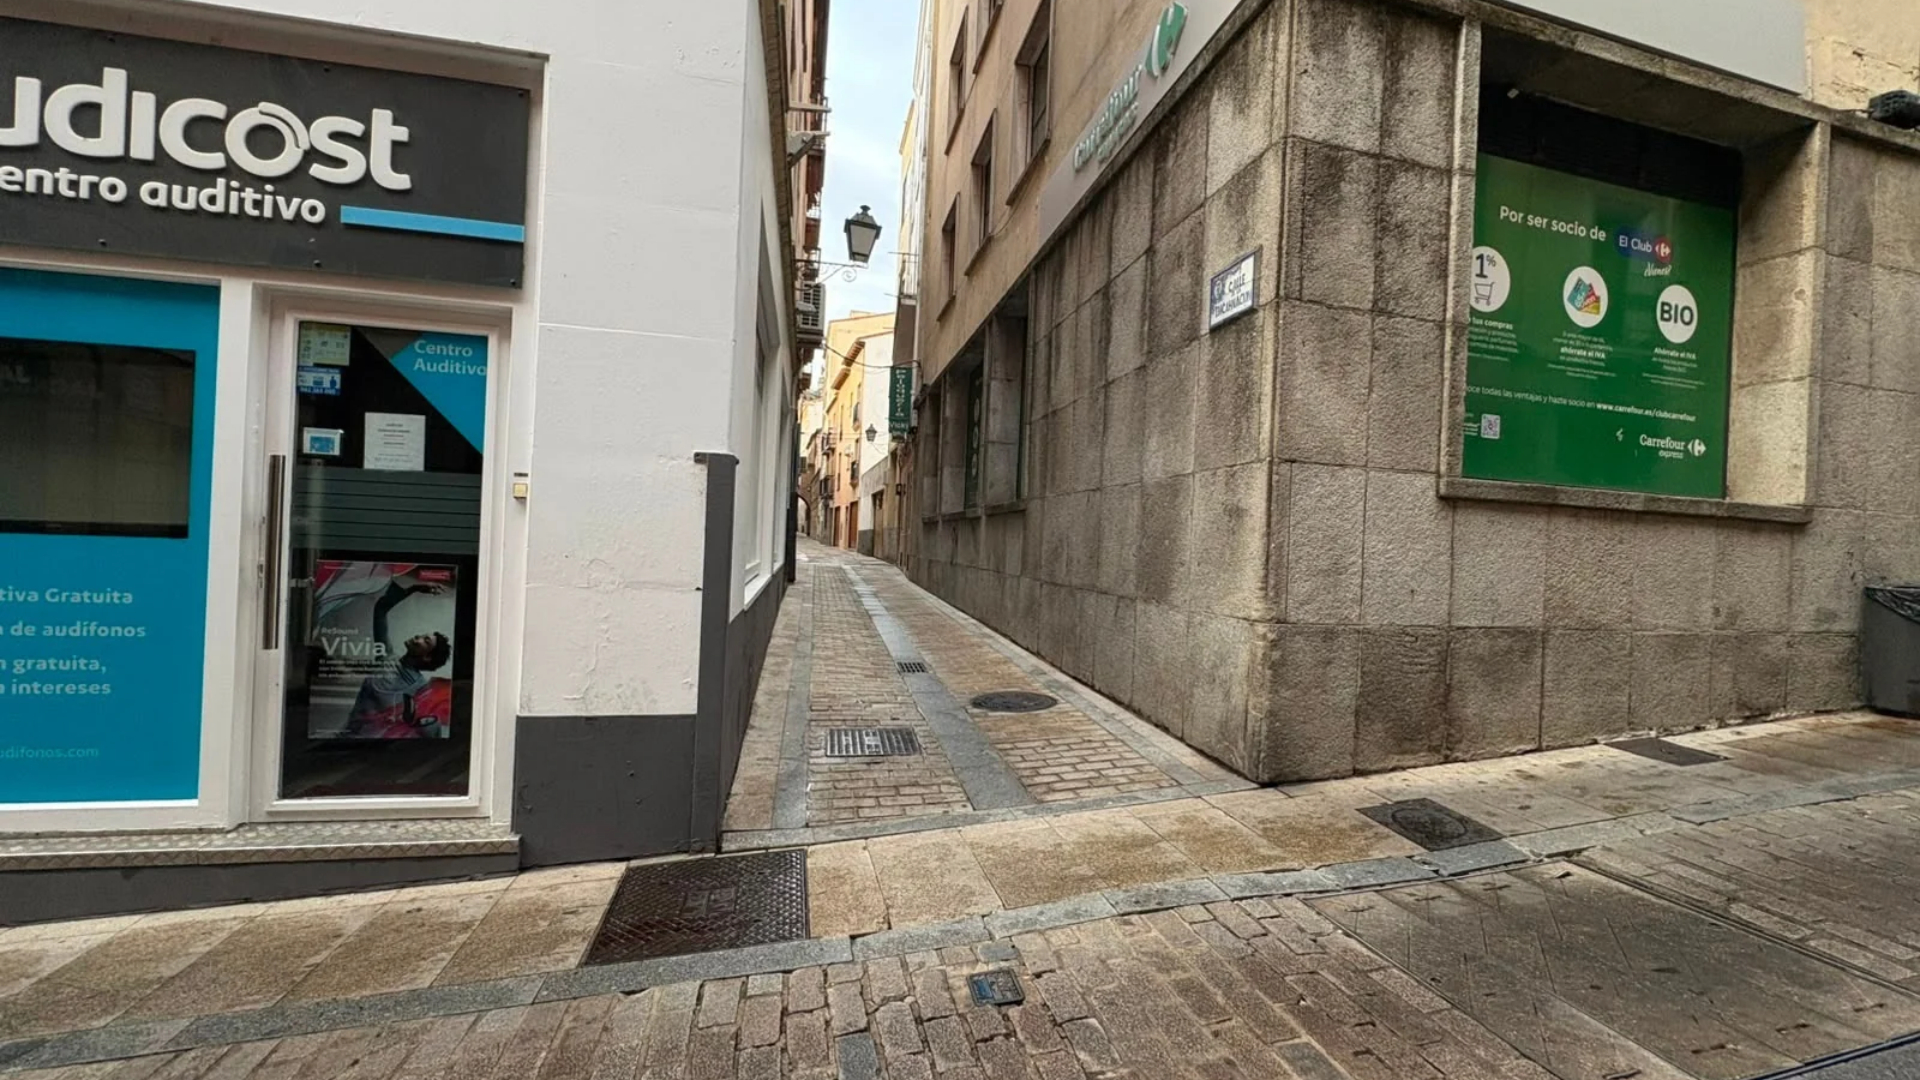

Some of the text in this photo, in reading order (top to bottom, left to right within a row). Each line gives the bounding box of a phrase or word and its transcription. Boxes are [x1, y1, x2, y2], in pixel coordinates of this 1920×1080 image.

[0, 165, 326, 224] entro auditivo
[1499, 205, 1607, 242] Por ser socio de
[1619, 234, 1653, 253] El Club
[1659, 301, 1694, 327] BIO
[1484, 318, 1514, 331] compras
[413, 338, 474, 358] Centro
[412, 358, 487, 377] Auditivo
[1481, 386, 1502, 397] todas
[1502, 388, 1513, 398] las
[1514, 391, 1543, 402] ventajas
[1548, 394, 1568, 405] hazte
[1568, 398, 1586, 408] socio
[1586, 401, 1596, 409] en
[1639, 433, 1686, 451] Carrefour
[1658, 449, 1684, 460] express
[45, 587, 134, 604] Gratuita
[10, 619, 36, 637] de
[42, 620, 147, 638] audífonos
[321, 636, 388, 657] Vivia
[12, 654, 107, 675] gratuita,
[11, 678, 112, 695] intereses
